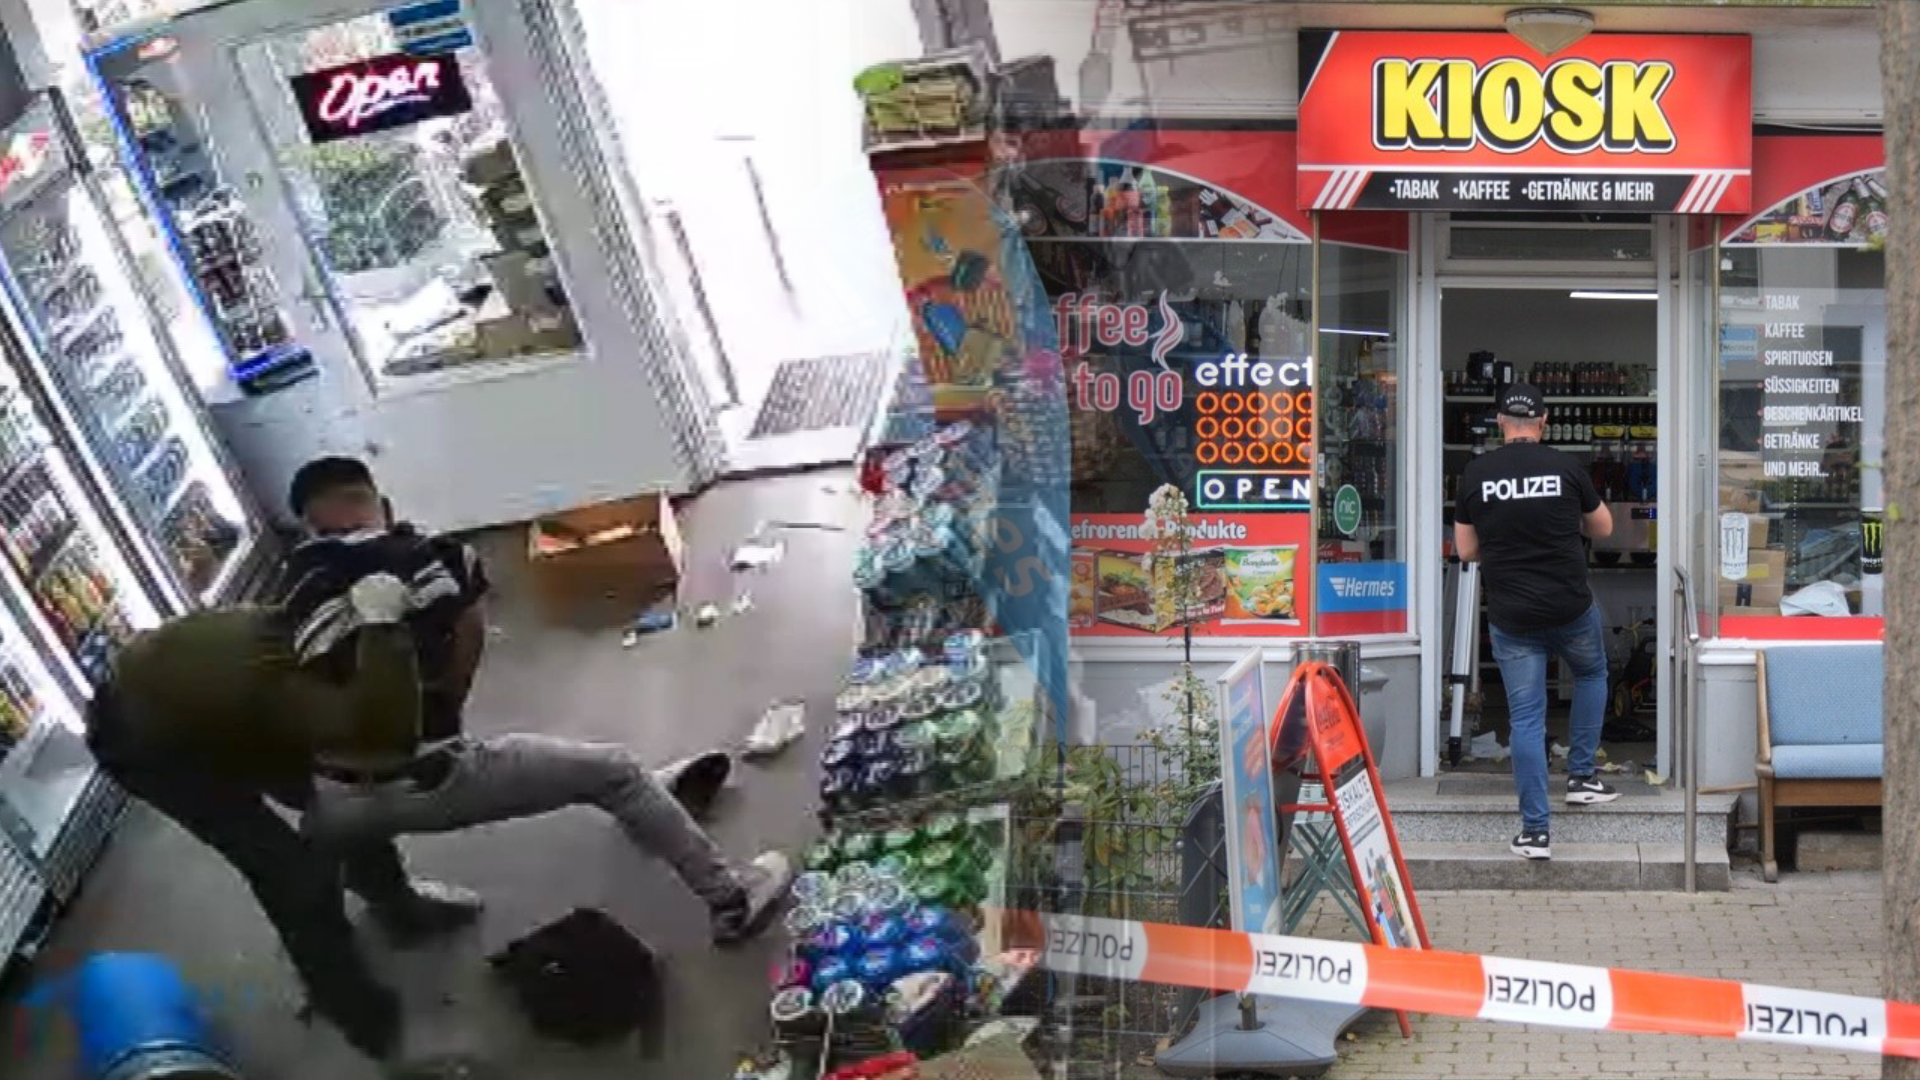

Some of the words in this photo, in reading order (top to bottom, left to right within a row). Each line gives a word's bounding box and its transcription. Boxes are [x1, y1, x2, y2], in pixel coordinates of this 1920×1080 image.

[319, 62, 441, 127] Open
[1373, 58, 1676, 153] KIOSK
[1394, 179, 1439, 199] TABAK
[1459, 180, 1510, 200] KAFFEE
[1528, 178, 1598, 201] GETRÄNKE
[1602, 182, 1611, 200] &
[1615, 182, 1654, 201] MEHR
[1765, 295, 1800, 310] TABAK
[1765, 323, 1805, 338] KAFFEE
[1765, 351, 1833, 366] SPIRITUOSEN
[1195, 354, 1312, 386] effect
[1072, 361, 1120, 411] to
[1128, 370, 1183, 425] go
[1764, 376, 1839, 394] SÜSSIGKEITEN
[1764, 431, 1819, 449] GETRÄNKE
[1764, 461, 1785, 477] UND
[1788, 461, 1829, 477] MEHR...
[1204, 479, 1311, 499] OPEN
[1482, 475, 1561, 502] POLIZEI
[1345, 577, 1395, 597] Hermes
[1256, 950, 1351, 985] POLIZEI
[1488, 974, 1595, 1013] POLIZEI
